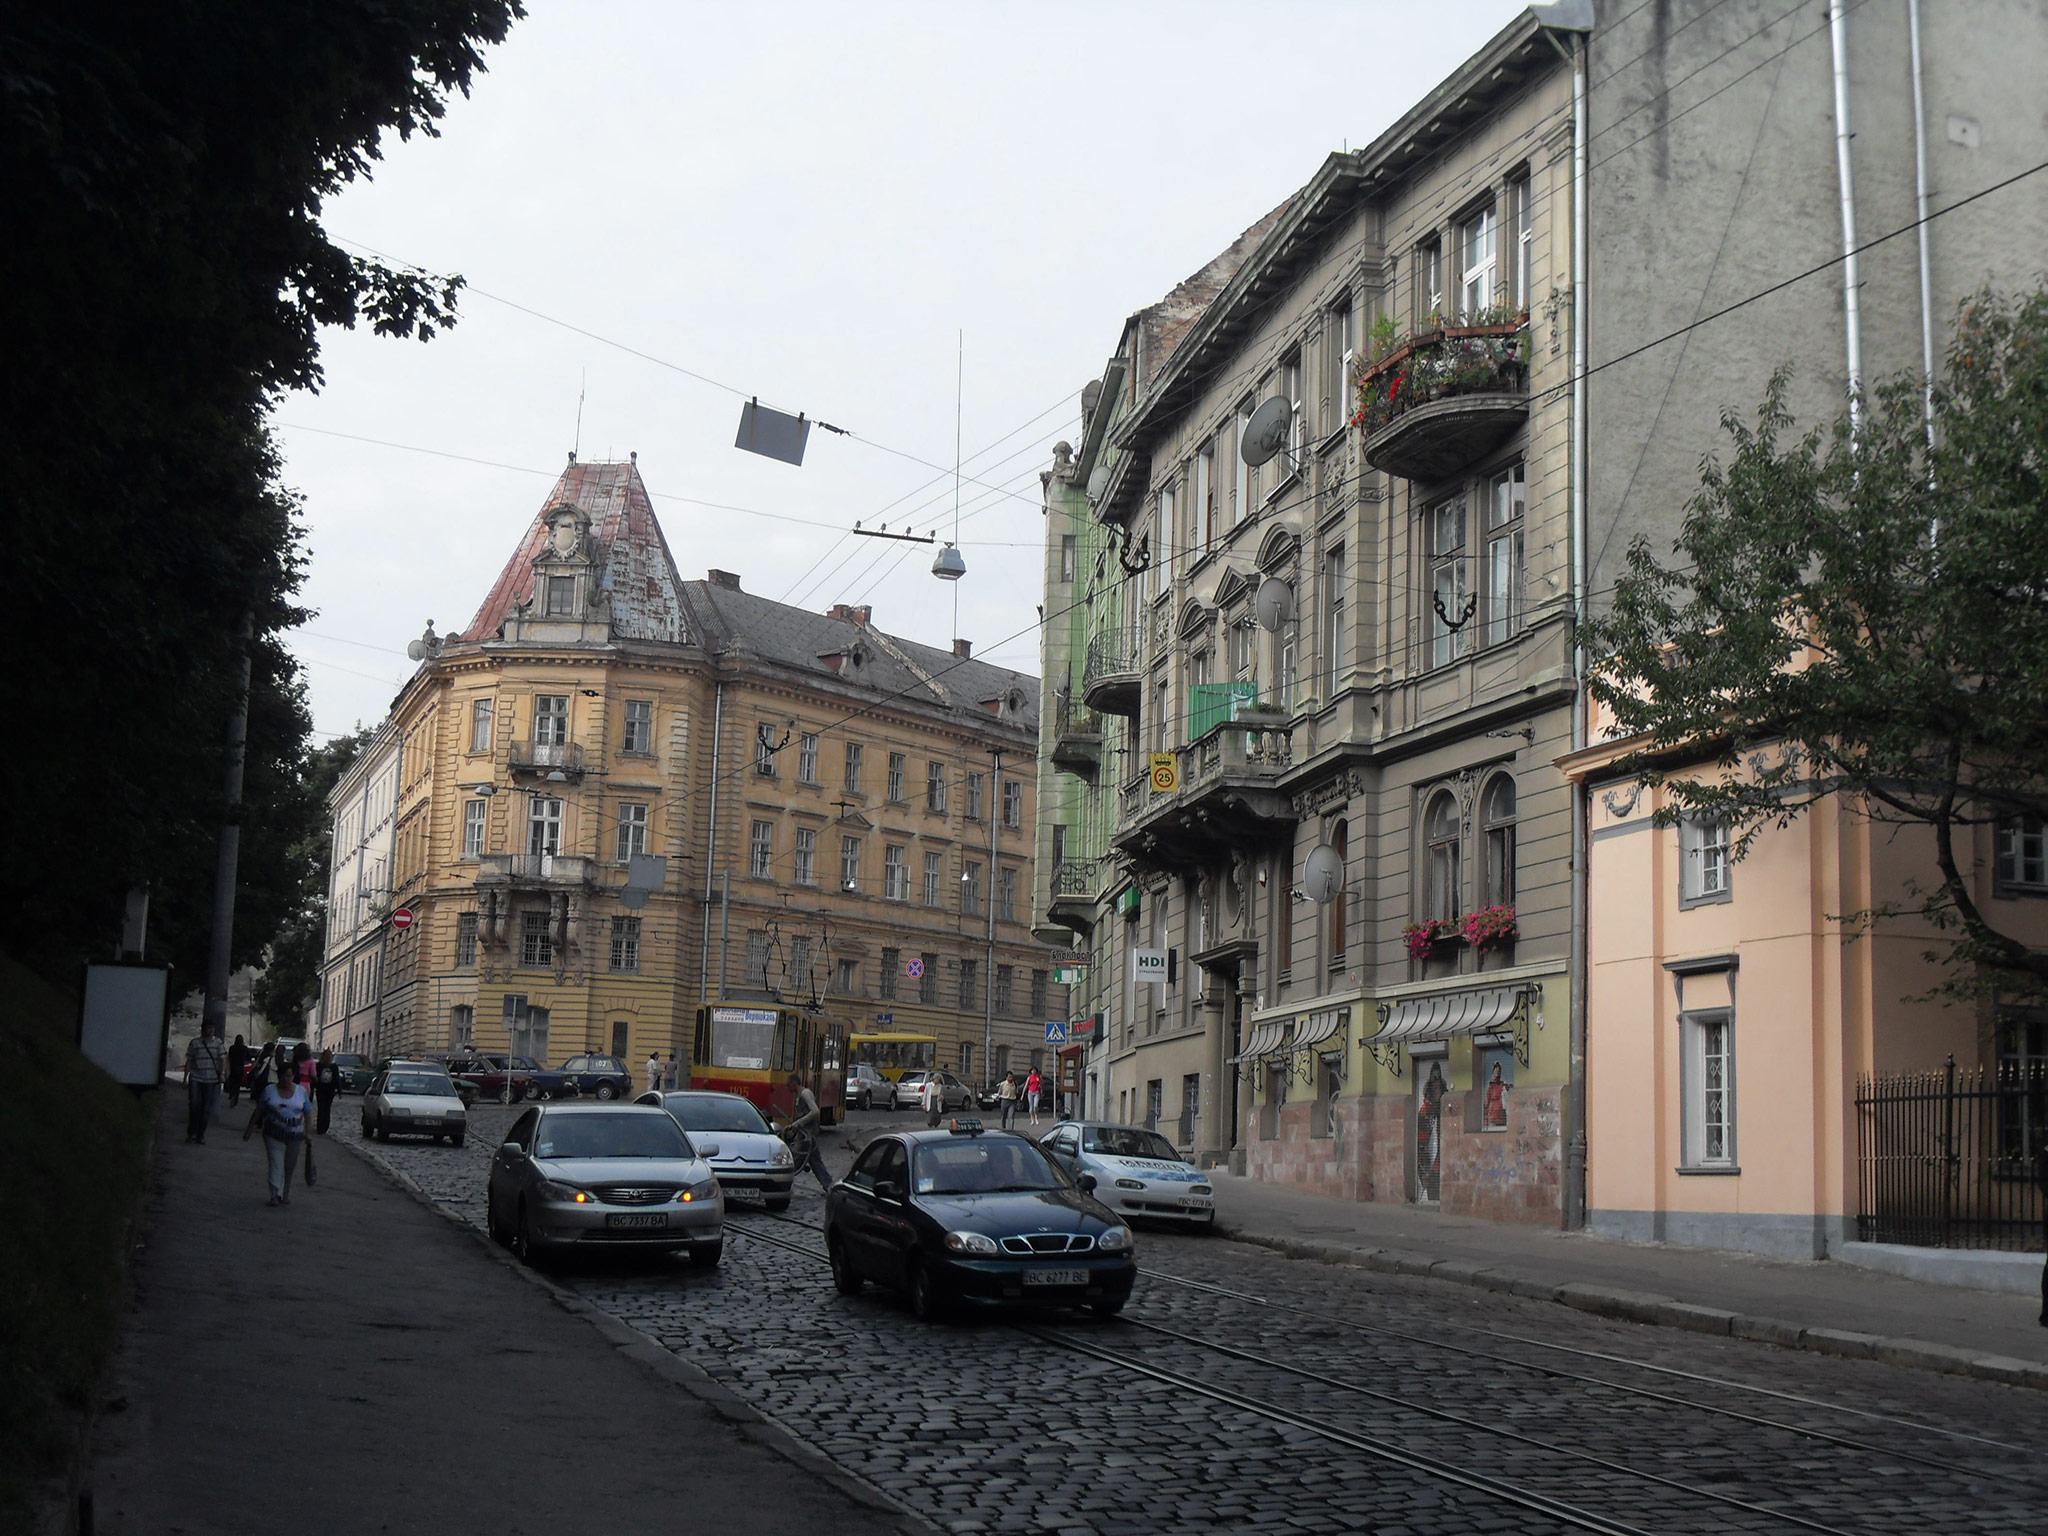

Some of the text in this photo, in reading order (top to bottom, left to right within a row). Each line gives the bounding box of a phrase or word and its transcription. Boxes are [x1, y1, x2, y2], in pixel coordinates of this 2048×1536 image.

[1158, 773, 1171, 783] 25
[1139, 956, 1165, 967] HDI
[756, 1059, 762, 1067] 2
[613, 1215, 627, 1226] BC
[651, 1215, 664, 1226] BA
